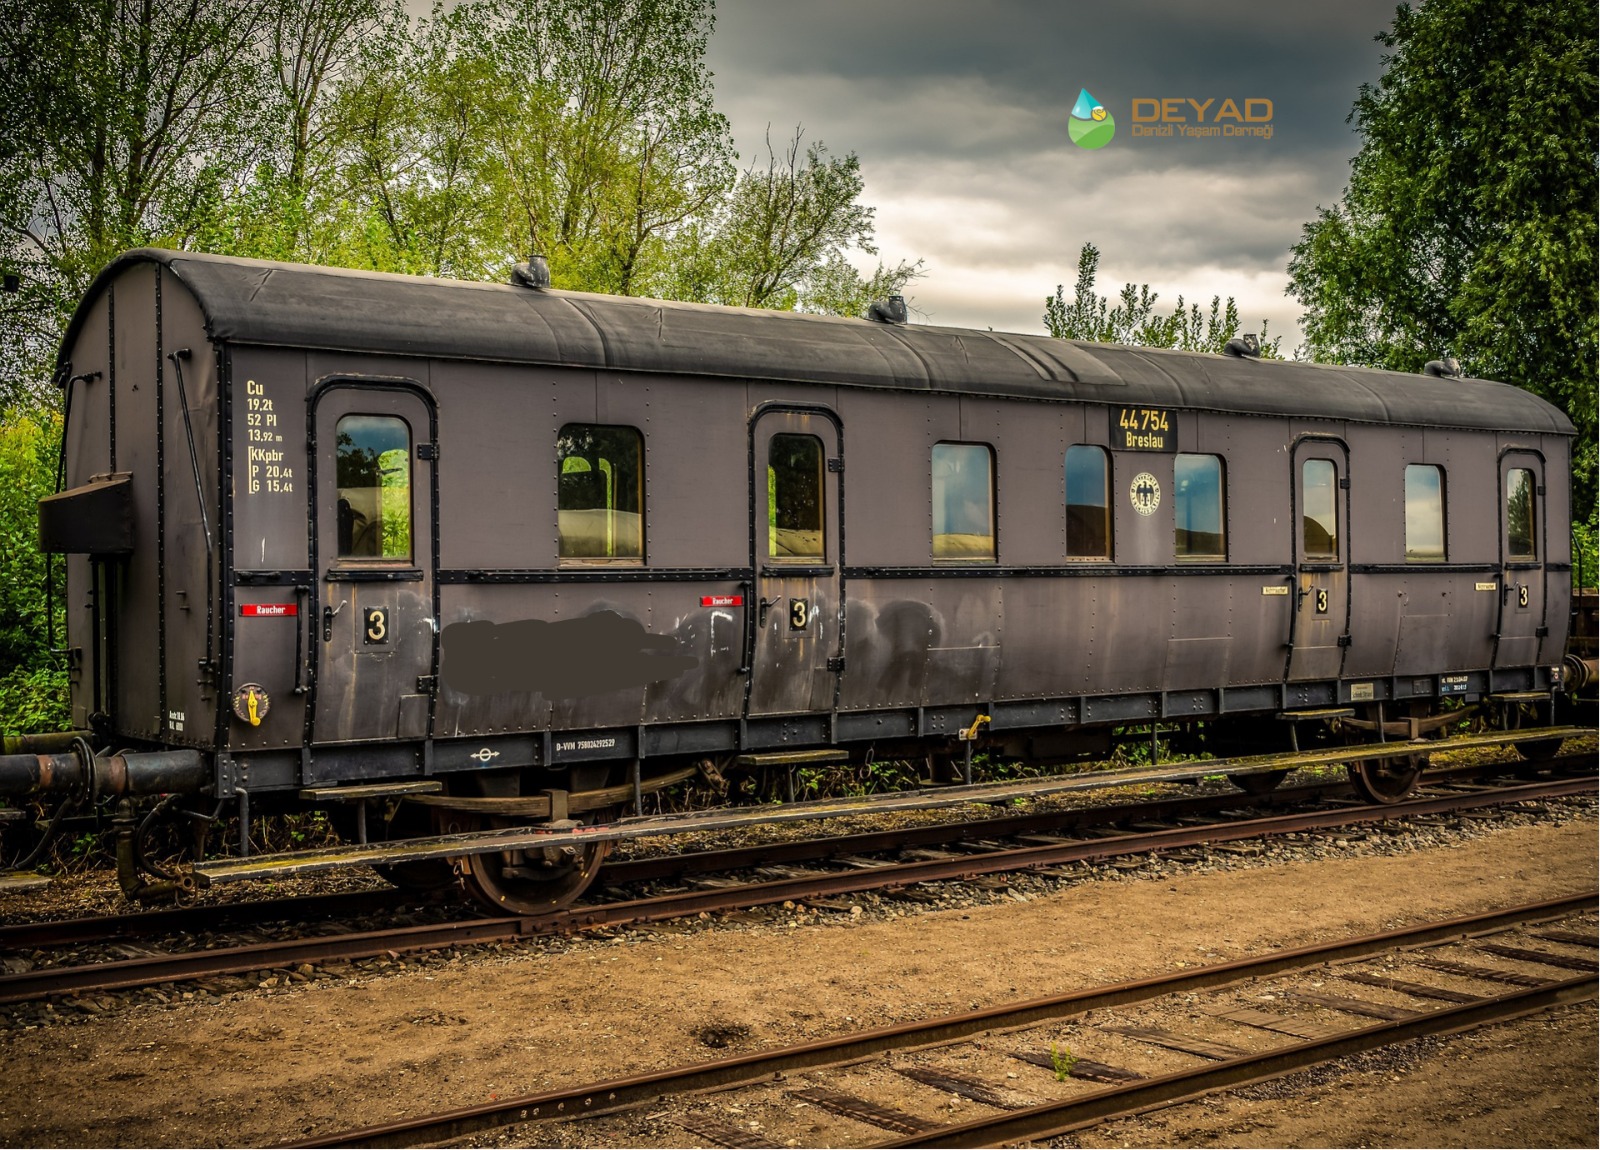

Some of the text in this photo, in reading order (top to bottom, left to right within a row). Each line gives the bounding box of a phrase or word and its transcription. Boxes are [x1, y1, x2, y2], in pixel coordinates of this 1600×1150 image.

[246, 380, 263, 395] Cu
[247, 414, 261, 426] 52
[1120, 409, 1168, 431] 44 754
[275, 434, 283, 442] m
[1126, 432, 1163, 448] Breslau
[251, 449, 283, 463] KKpbr
[252, 465, 259, 477] P
[252, 479, 260, 492] G
[712, 597, 733, 605] Raucher
[1318, 591, 1327, 611] 3
[1520, 587, 1528, 606] 3
[256, 605, 286, 614] Raucher
[793, 602, 806, 627] 3
[368, 610, 385, 640] 3
